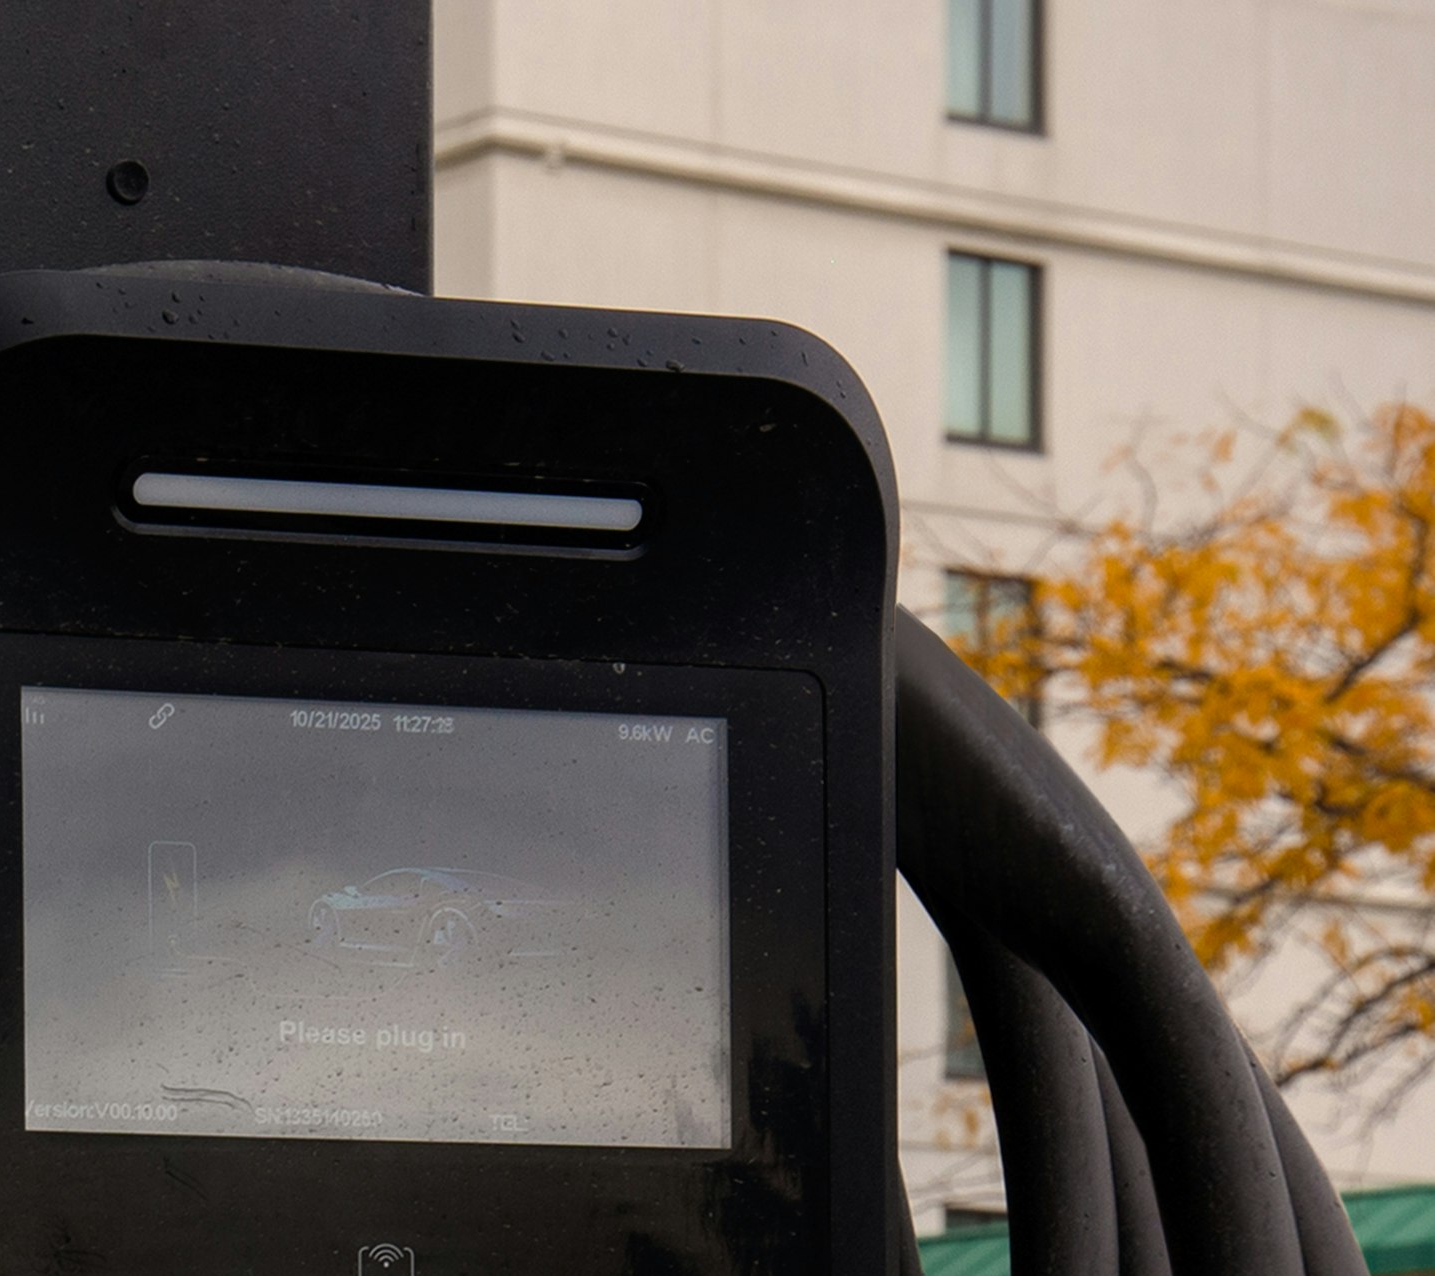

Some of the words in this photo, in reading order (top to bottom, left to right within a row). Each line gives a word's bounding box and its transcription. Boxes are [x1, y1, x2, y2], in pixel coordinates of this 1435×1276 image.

[289, 710, 382, 731] 10/21/2025
[618, 723, 674, 742] 9.6kW
[685, 727, 715, 744] AC
[279, 1020, 367, 1045] Please
[376, 1025, 434, 1053] plug
[442, 1026, 467, 1049] in
